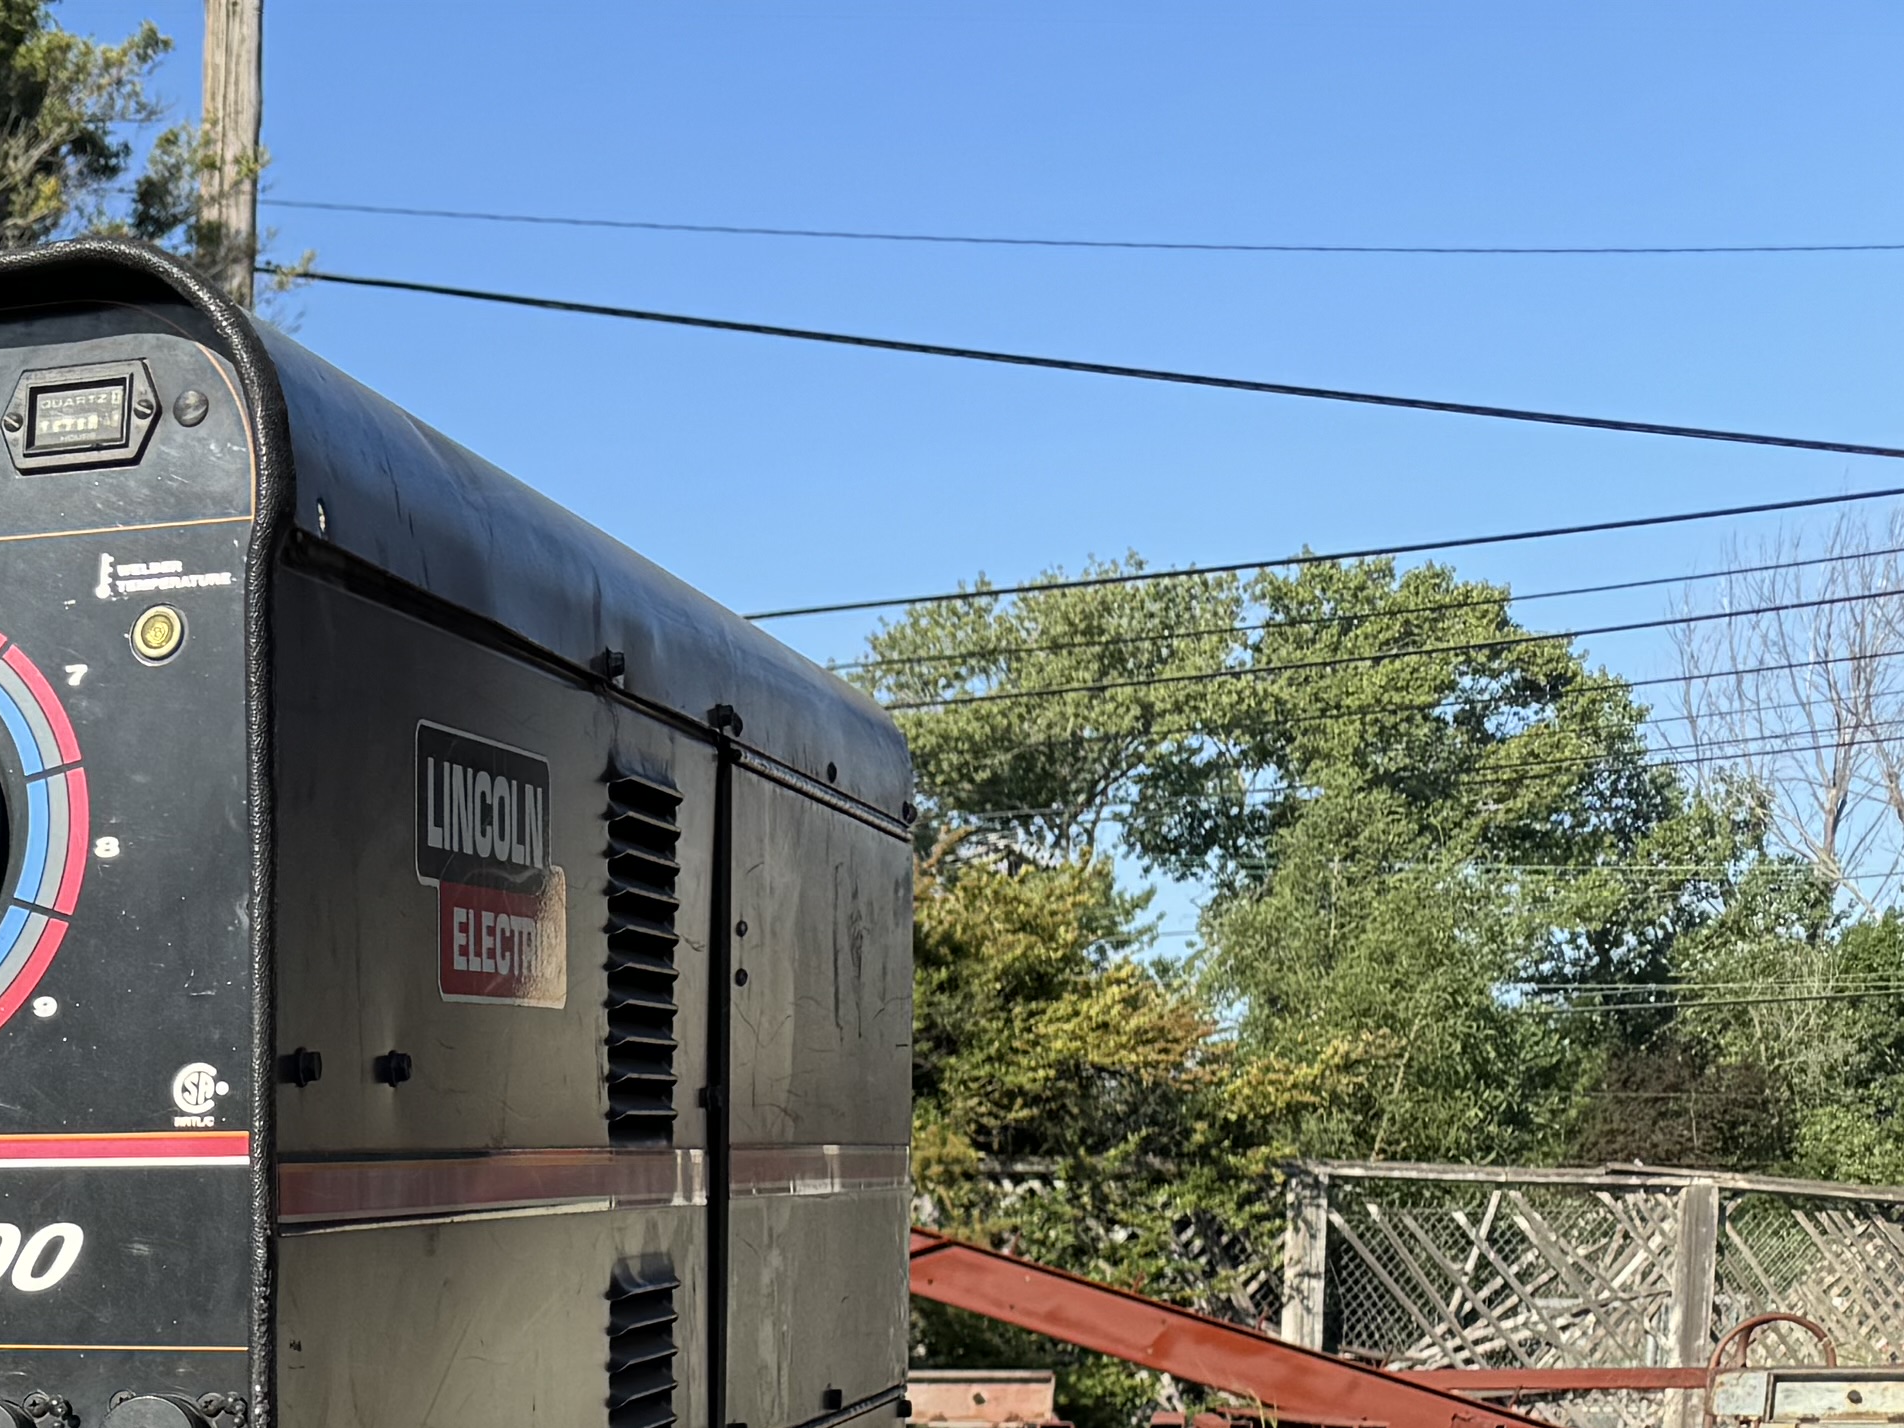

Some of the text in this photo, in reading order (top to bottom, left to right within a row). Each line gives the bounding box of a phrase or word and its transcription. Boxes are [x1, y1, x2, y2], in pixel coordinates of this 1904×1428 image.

[41, 394, 107, 409] QUARTZ
[65, 665, 88, 685] 7
[426, 756, 543, 869] LINCOLN
[95, 837, 121, 858] 8
[33, 995, 57, 1018] 9
